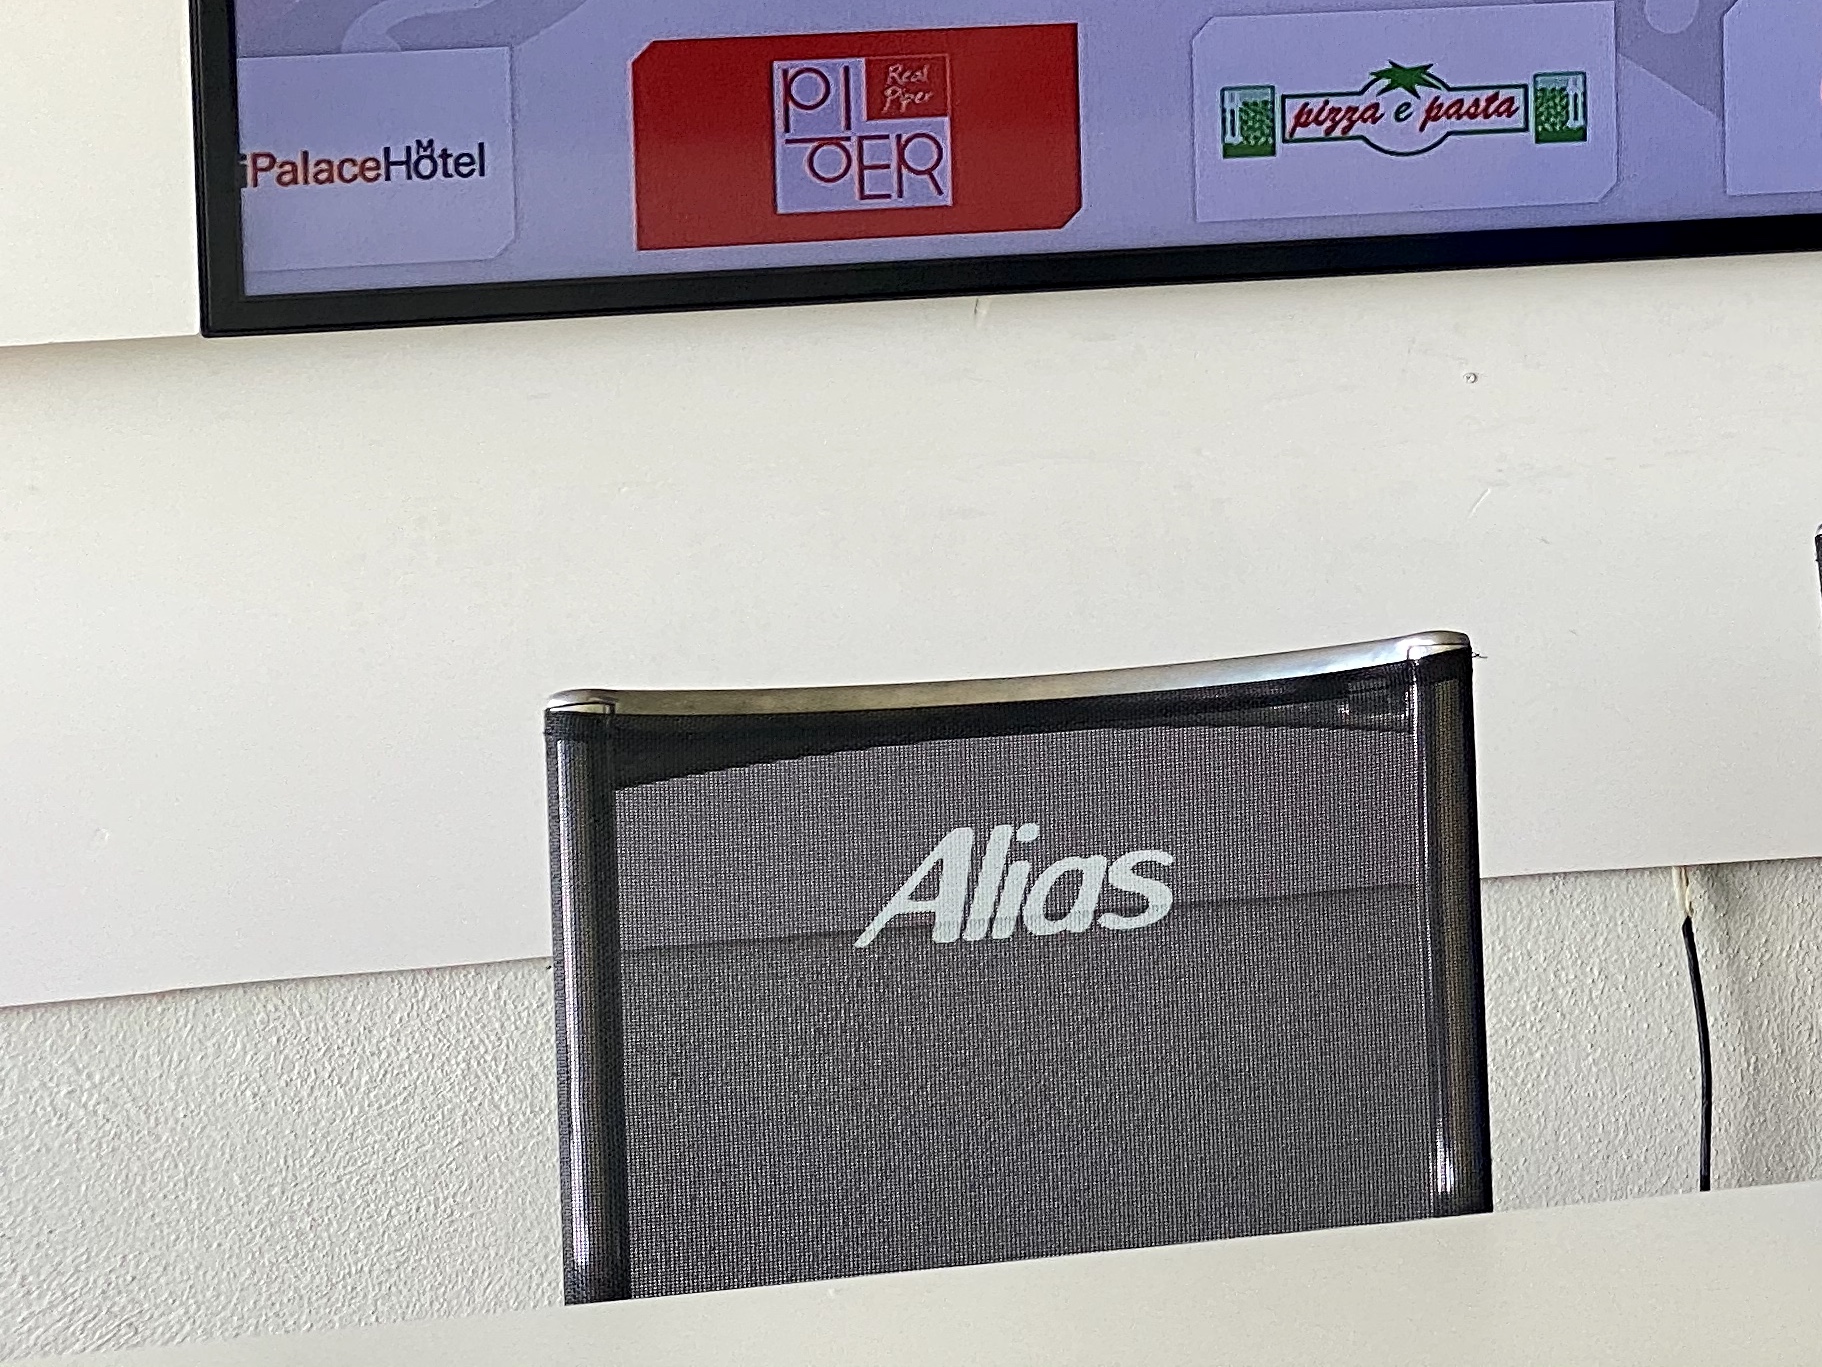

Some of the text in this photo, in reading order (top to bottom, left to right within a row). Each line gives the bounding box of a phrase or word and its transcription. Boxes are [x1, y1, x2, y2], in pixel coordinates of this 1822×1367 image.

[1289, 91, 1520, 138] pizza e pasta
[853, 822, 1175, 949] Alias
